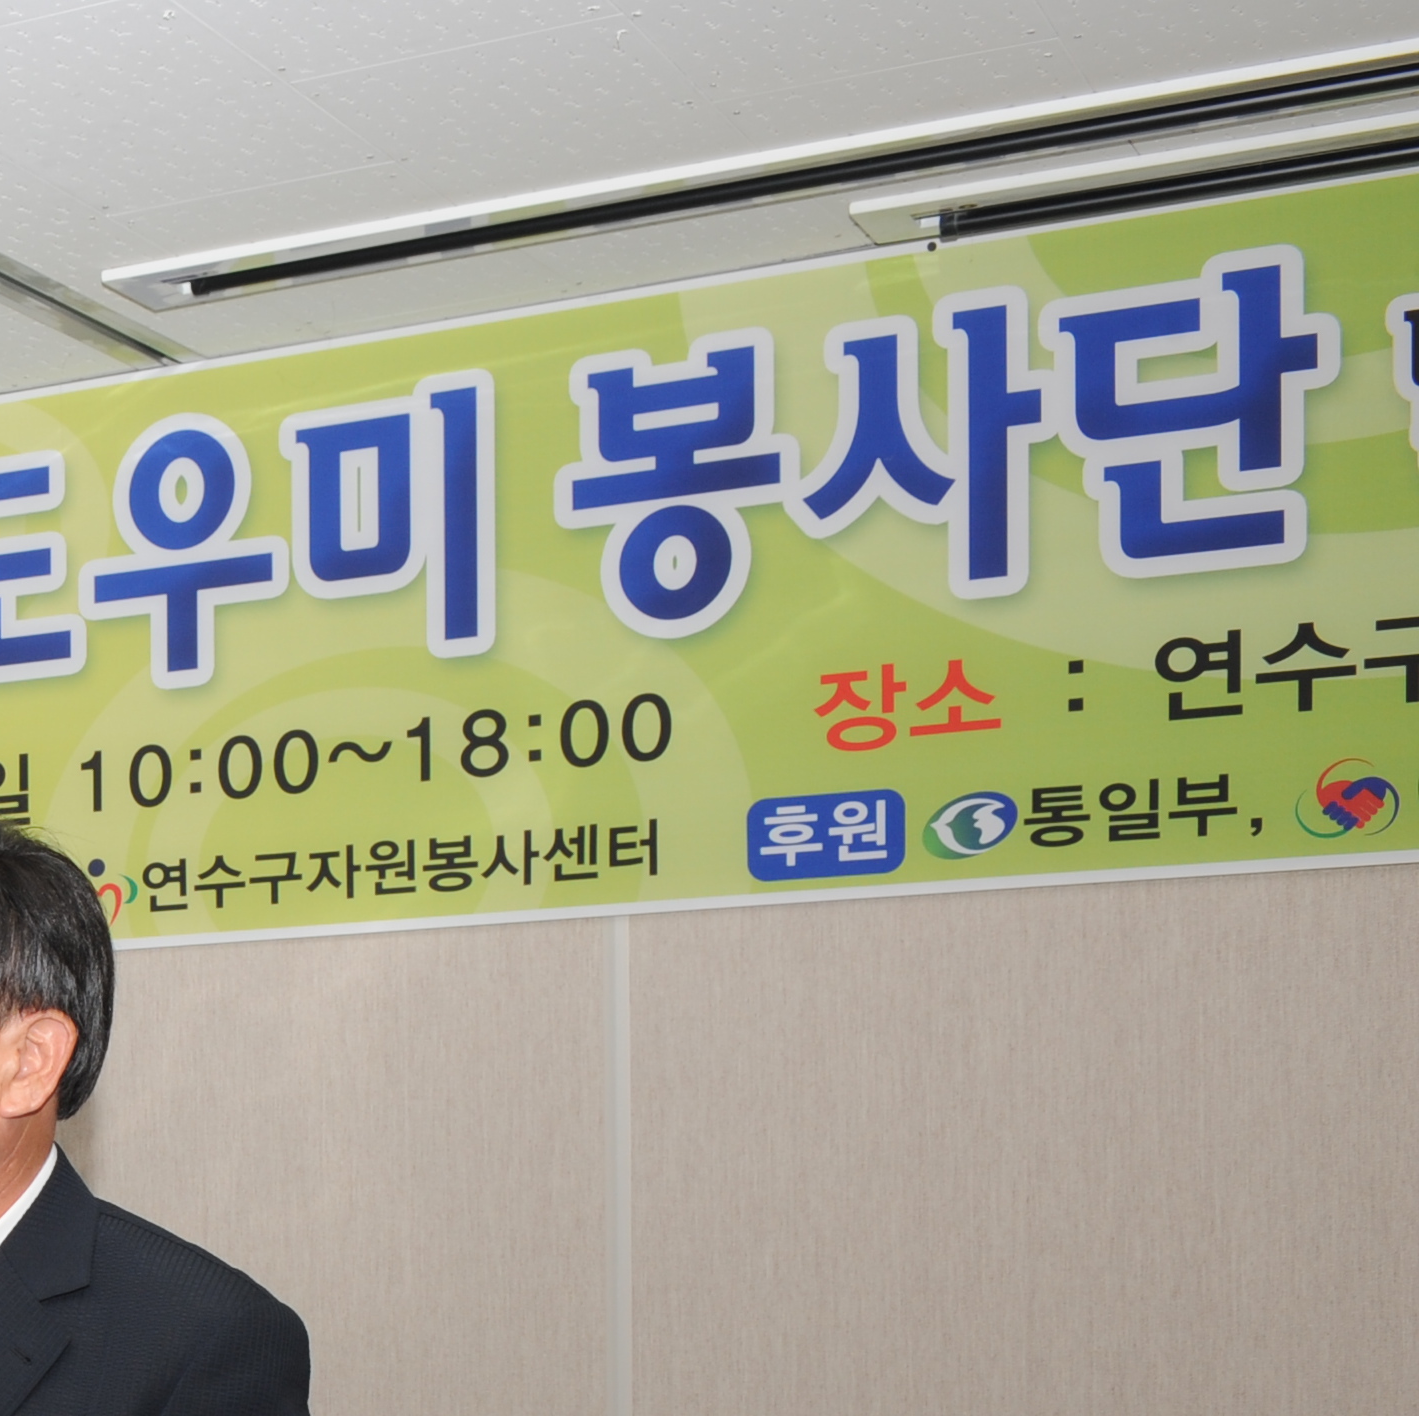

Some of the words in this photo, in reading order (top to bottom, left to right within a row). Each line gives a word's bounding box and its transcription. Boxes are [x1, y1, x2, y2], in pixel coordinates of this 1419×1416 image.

[572, 264, 1318, 621] 봉사단
[80, 692, 673, 813] 10:00~18:00
[814, 658, 1003, 753] 장소
[141, 817, 661, 913] 연수구자원봉사센터
[759, 799, 888, 867] 후원
[1022, 772, 1264, 838] 통일부,
